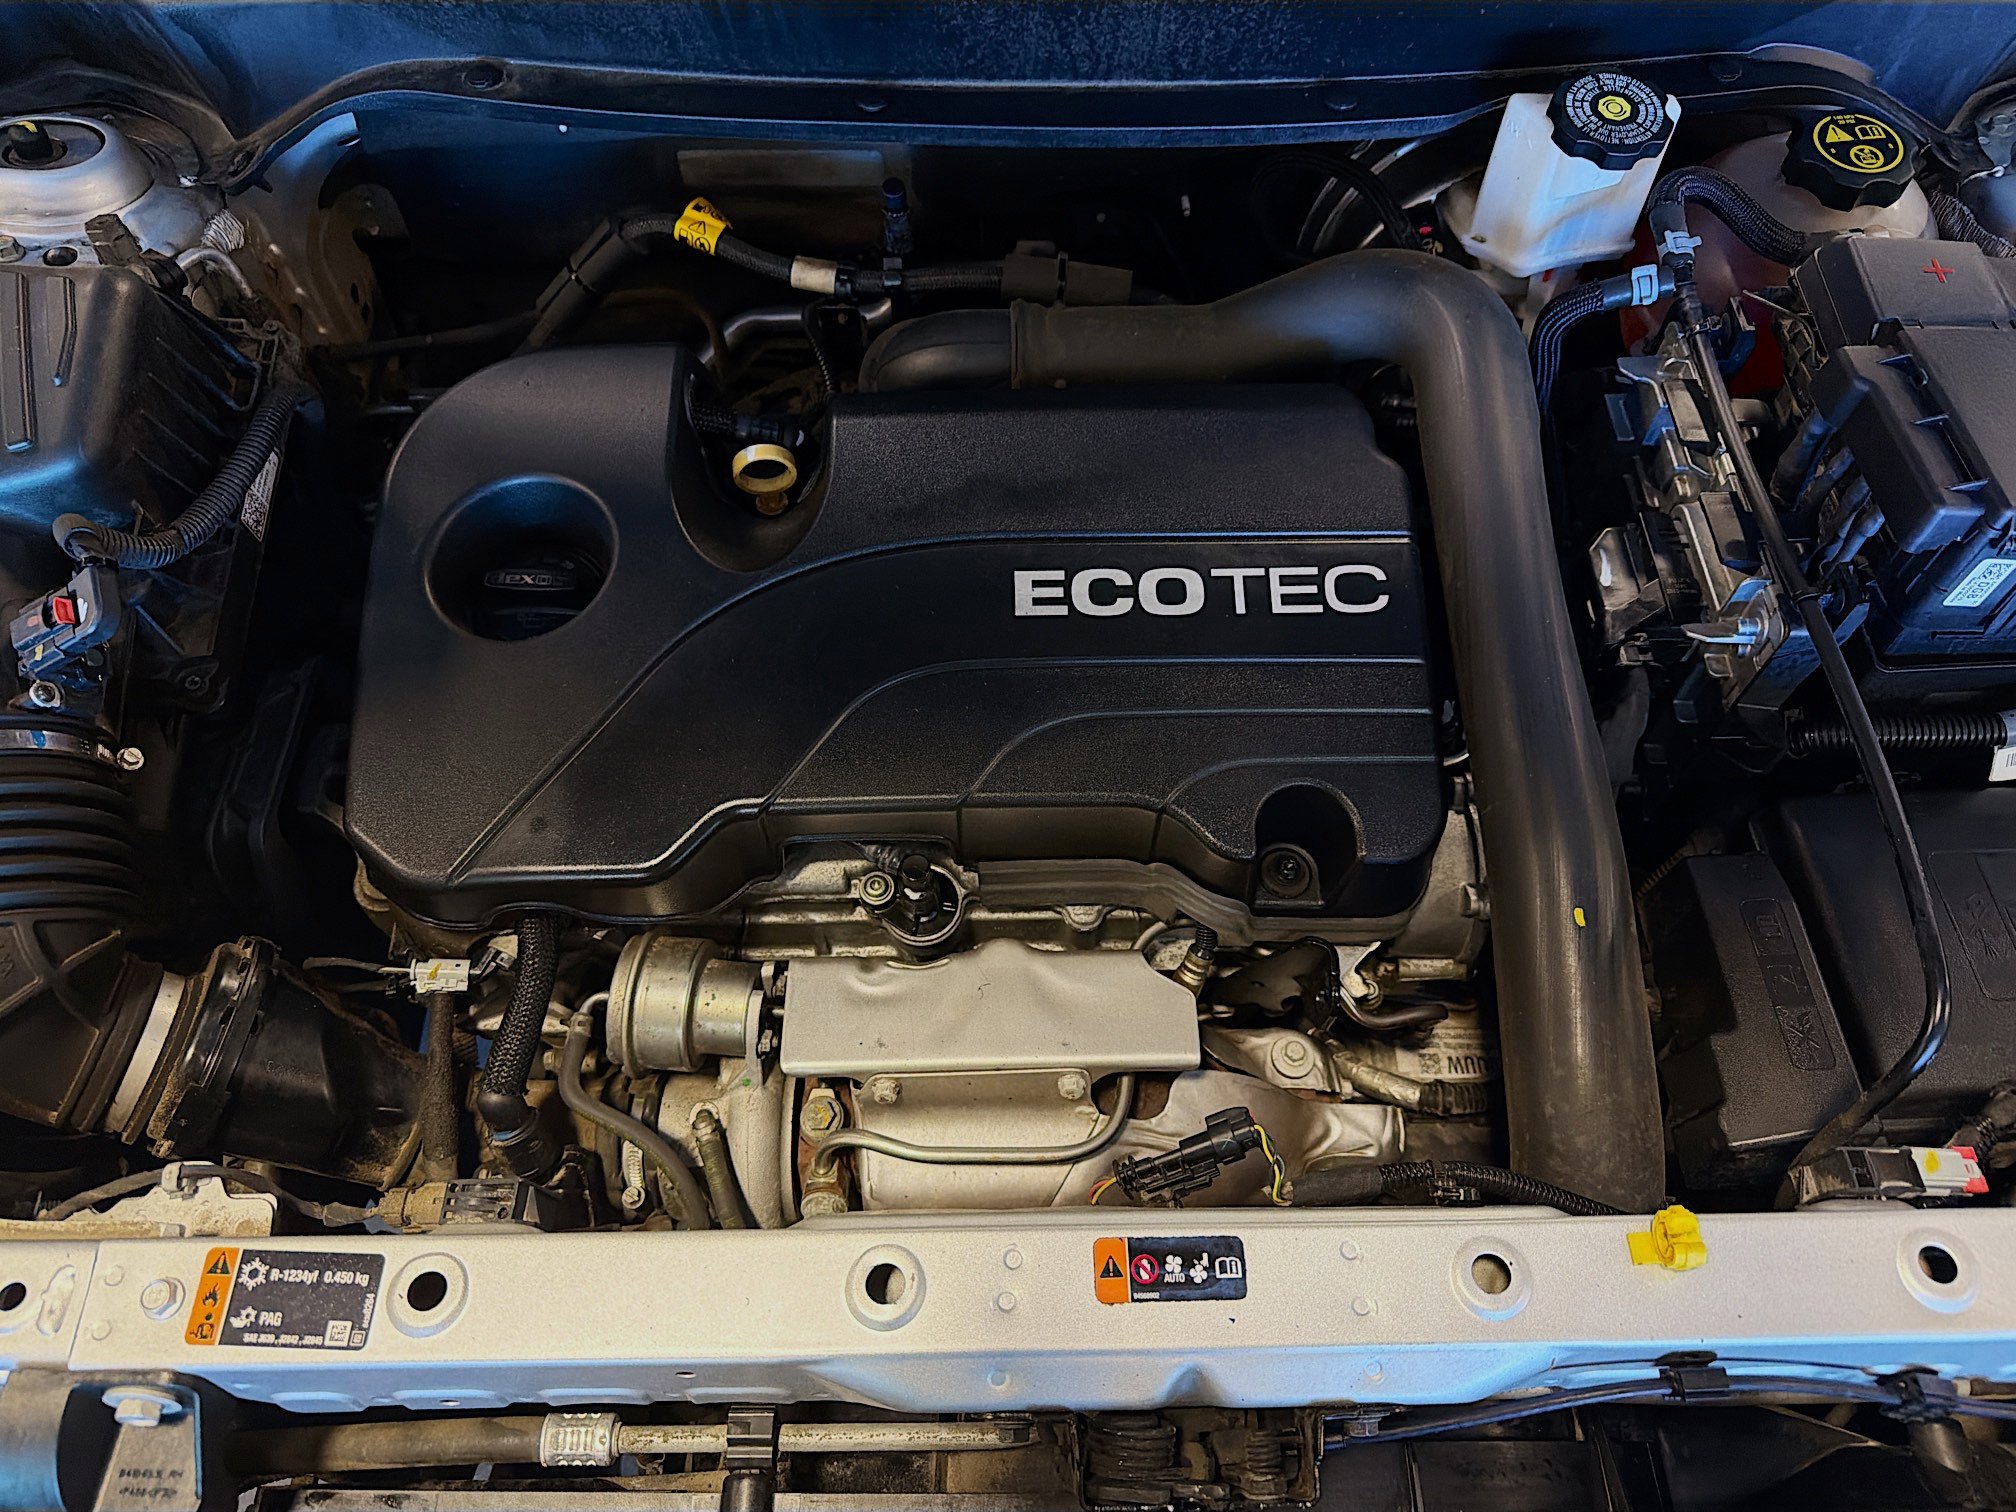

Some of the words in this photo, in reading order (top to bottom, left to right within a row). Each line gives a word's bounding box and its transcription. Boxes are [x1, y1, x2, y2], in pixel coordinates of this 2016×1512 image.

[1013, 565, 1390, 616] ECOTEC
[270, 1268, 318, 1285] R-1234yf
[323, 1270, 354, 1284] 0.450
[354, 1271, 370, 1287] kg
[1164, 1273, 1185, 1283] AUTO
[259, 1311, 283, 1327] PAG
